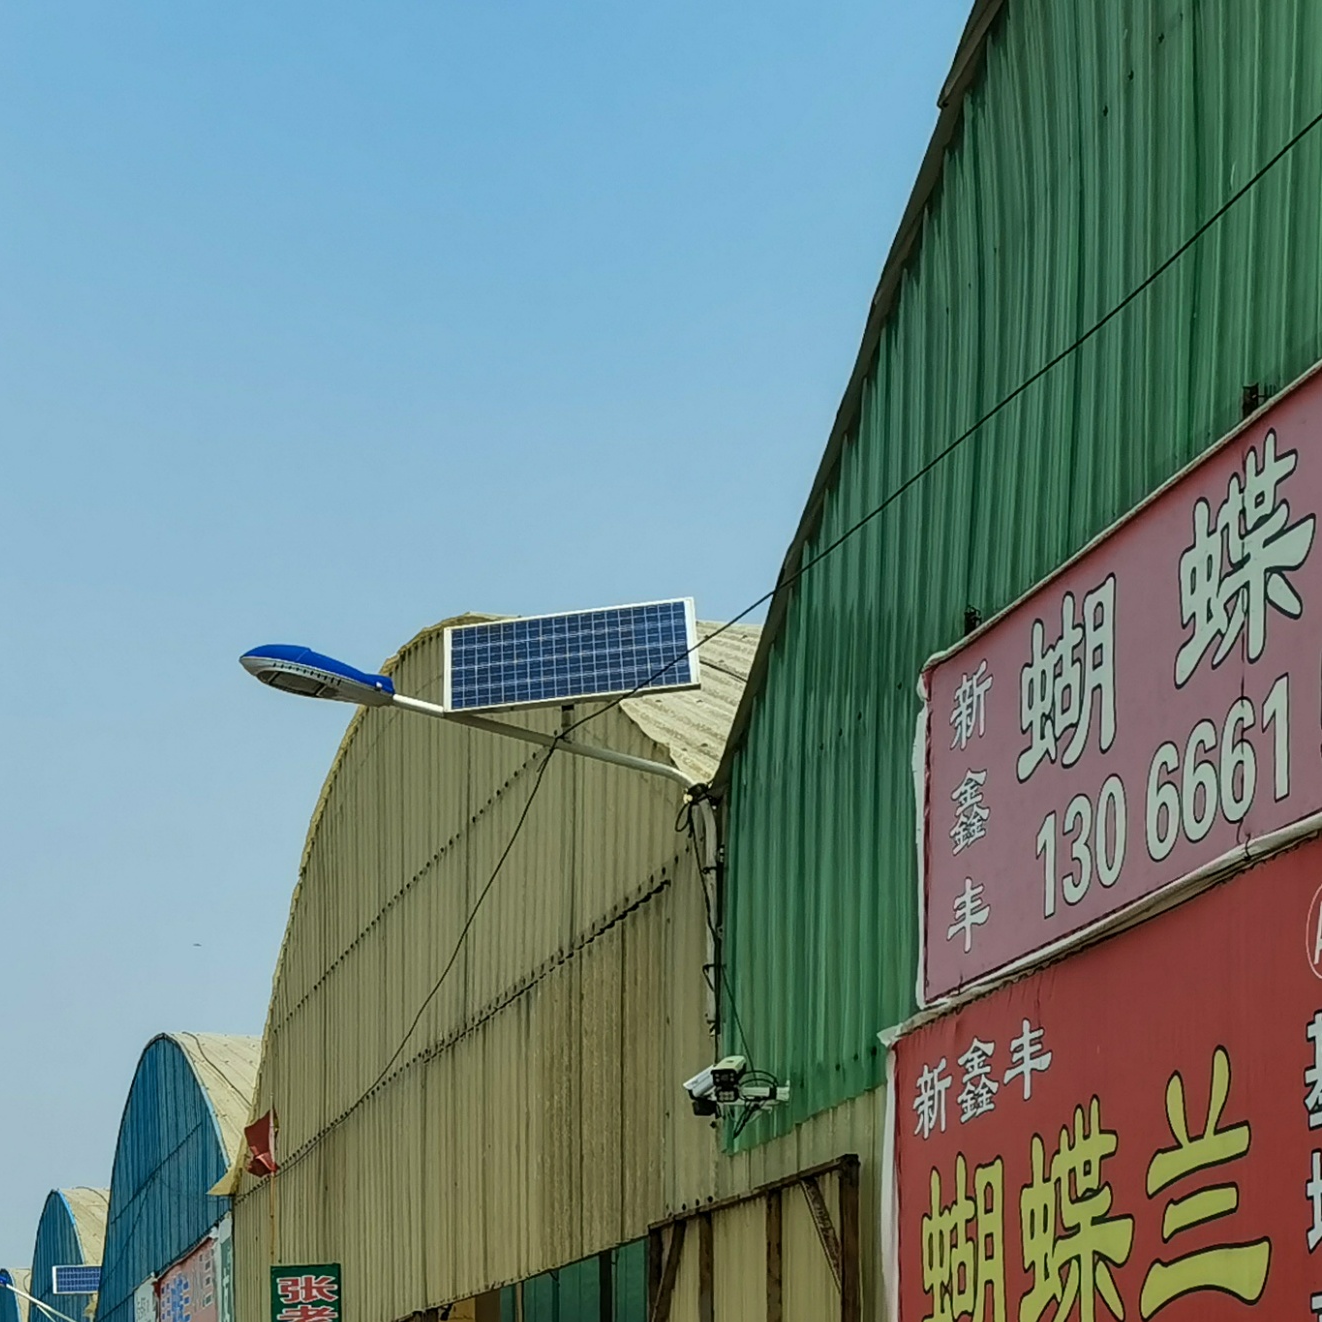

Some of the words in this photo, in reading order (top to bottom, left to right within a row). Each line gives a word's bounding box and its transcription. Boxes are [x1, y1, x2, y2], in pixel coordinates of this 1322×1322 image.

[948, 660, 993, 953] 新鑫丰
[1036, 773, 1127, 919] 130
[1145, 674, 1290, 862] 6661
[912, 1018, 1052, 1139] 新鑫丰
